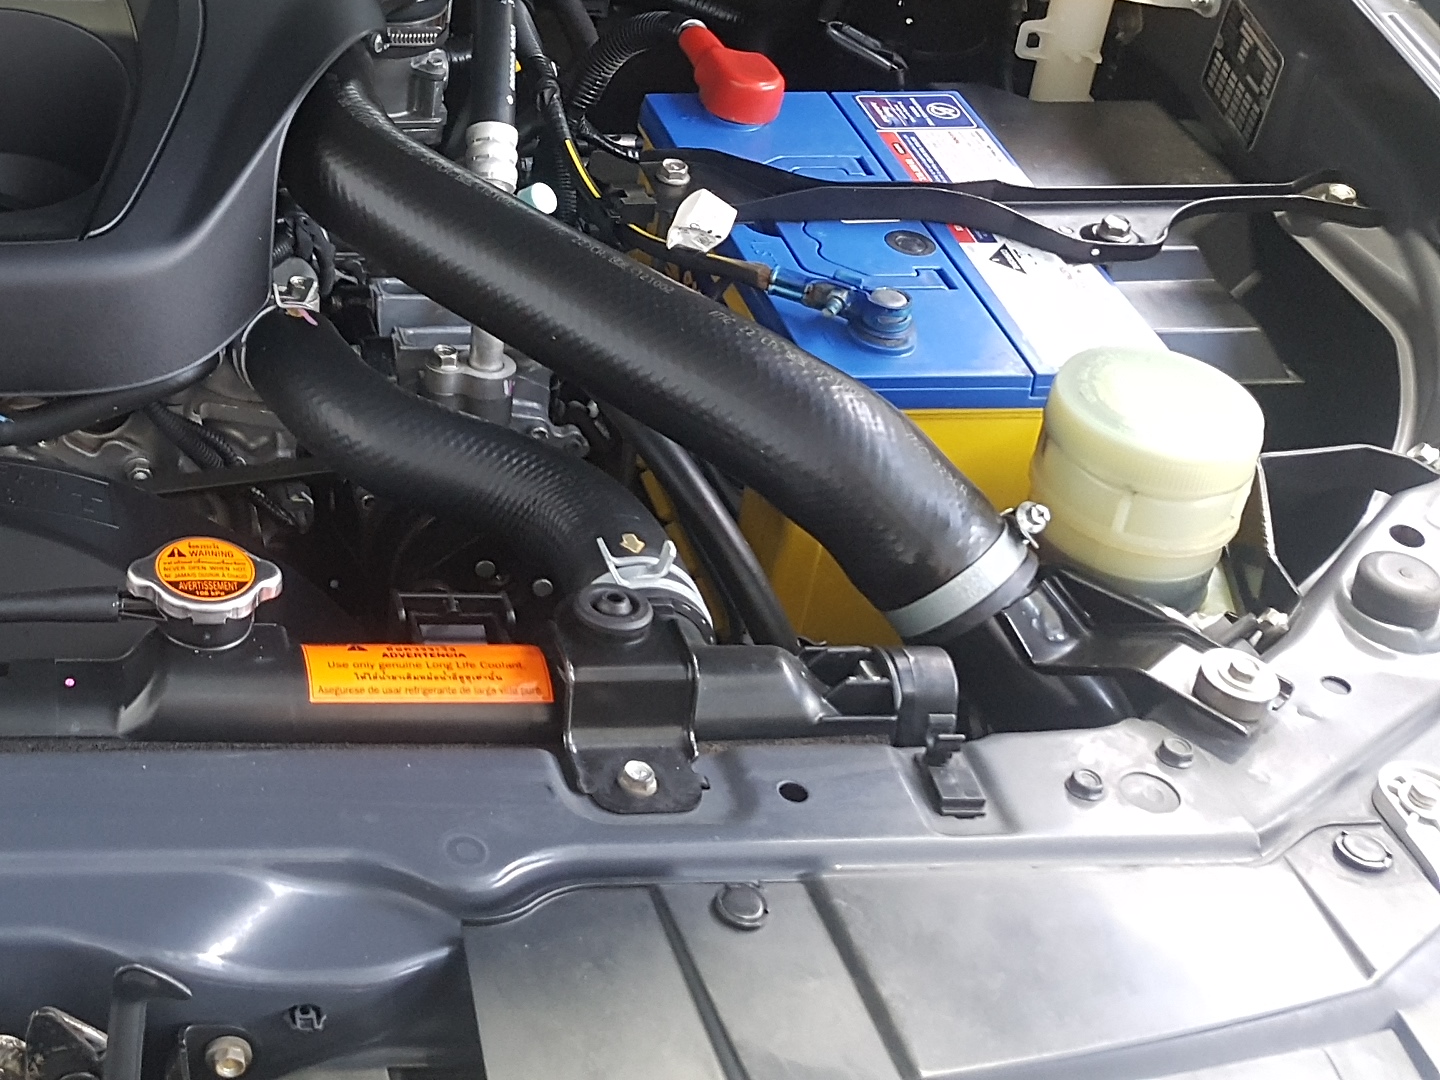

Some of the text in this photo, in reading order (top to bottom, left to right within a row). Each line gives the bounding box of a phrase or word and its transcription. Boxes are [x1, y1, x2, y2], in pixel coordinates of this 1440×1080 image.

[188, 550, 234, 558] WARNING
[178, 580, 239, 591] AVERTISSEMENT
[327, 661, 349, 669] Use
[352, 660, 375, 671] only
[378, 661, 423, 671] genuine
[425, 661, 453, 671] Long
[456, 661, 477, 670] Life
[318, 685, 365, 697] Asegurese
[367, 685, 380, 695] de
[382, 686, 402, 695] usar
[404, 685, 457, 697] refrigerante
[459, 685, 472, 695] de
